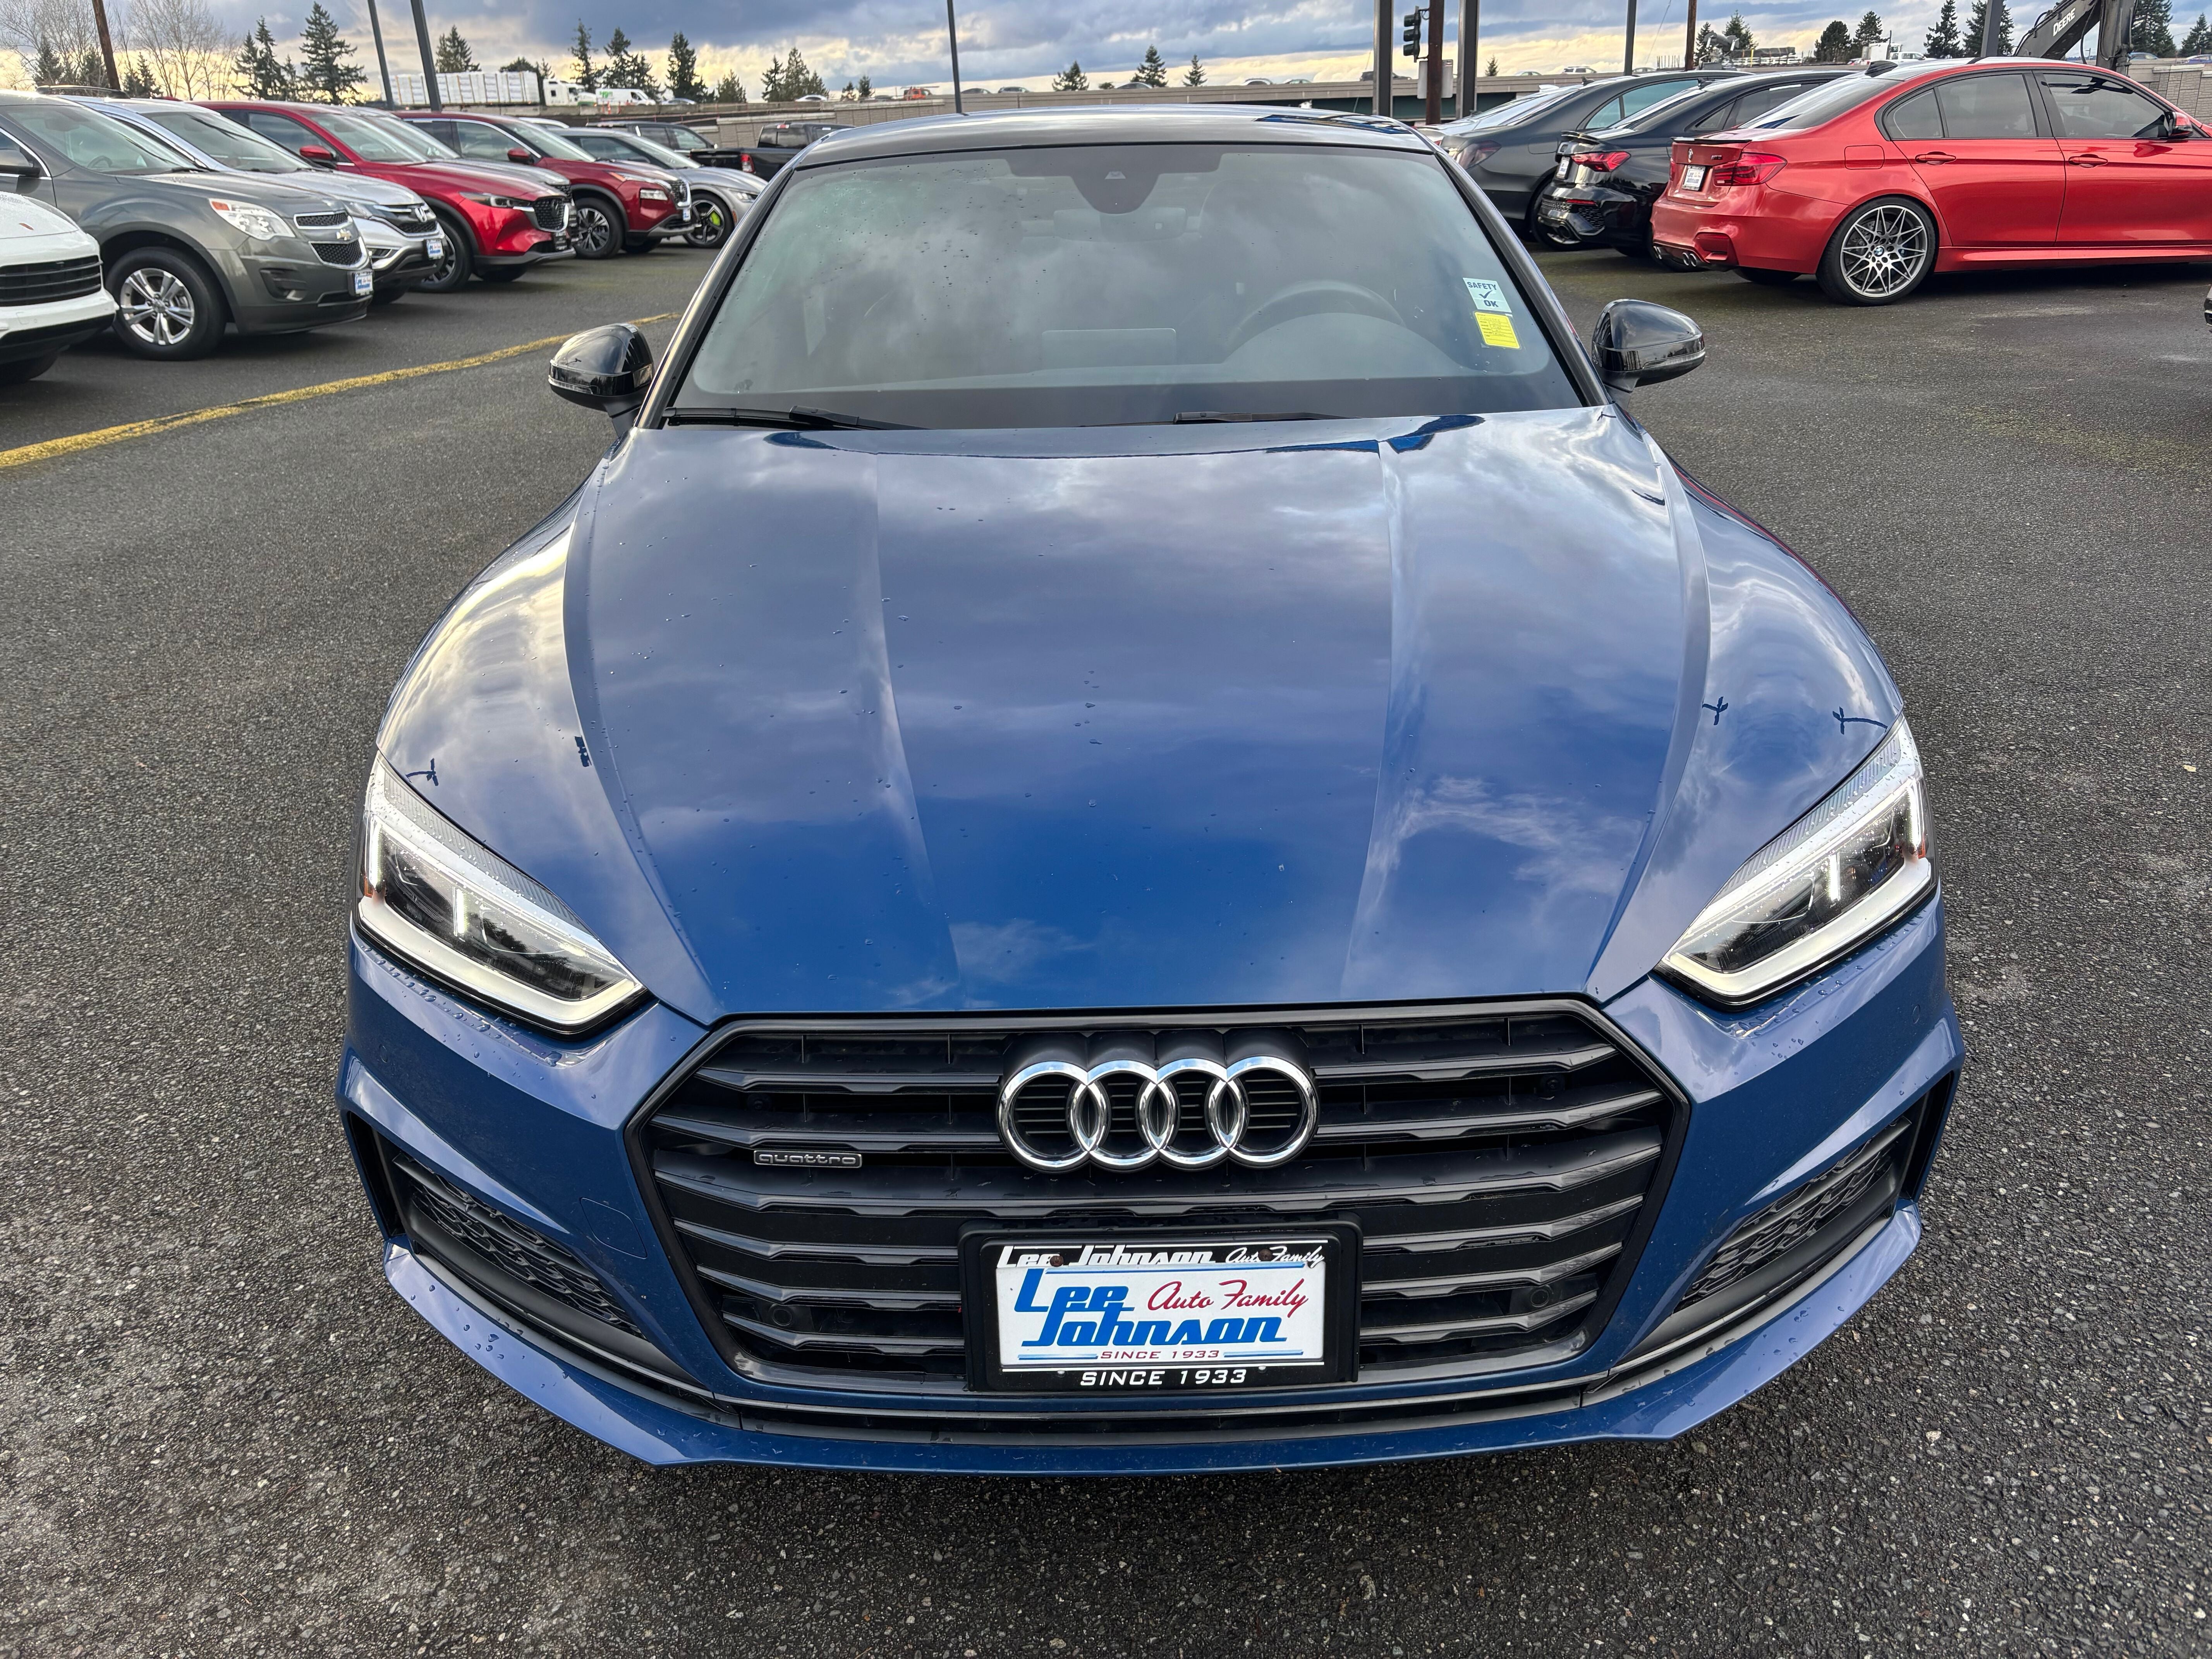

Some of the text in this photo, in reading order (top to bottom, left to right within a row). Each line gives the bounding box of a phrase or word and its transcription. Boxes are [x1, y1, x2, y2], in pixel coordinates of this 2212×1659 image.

[2053, 8, 2076, 36] DEERE
[1467, 282, 1497, 290] SAFETY
[759, 1154, 856, 1164] quattro
[1068, 1244, 1216, 1266] Johnson
[1225, 1247, 1266, 1263] Aut
[1270, 1245, 1324, 1268] Family
[1014, 1268, 1135, 1312] Lee
[1147, 1278, 1309, 1318] Auto Family
[1021, 1306, 1287, 1347] Johnson
[1100, 1350, 1219, 1359] SINCE 1933
[1080, 1369, 1247, 1386] SINCE 1933
